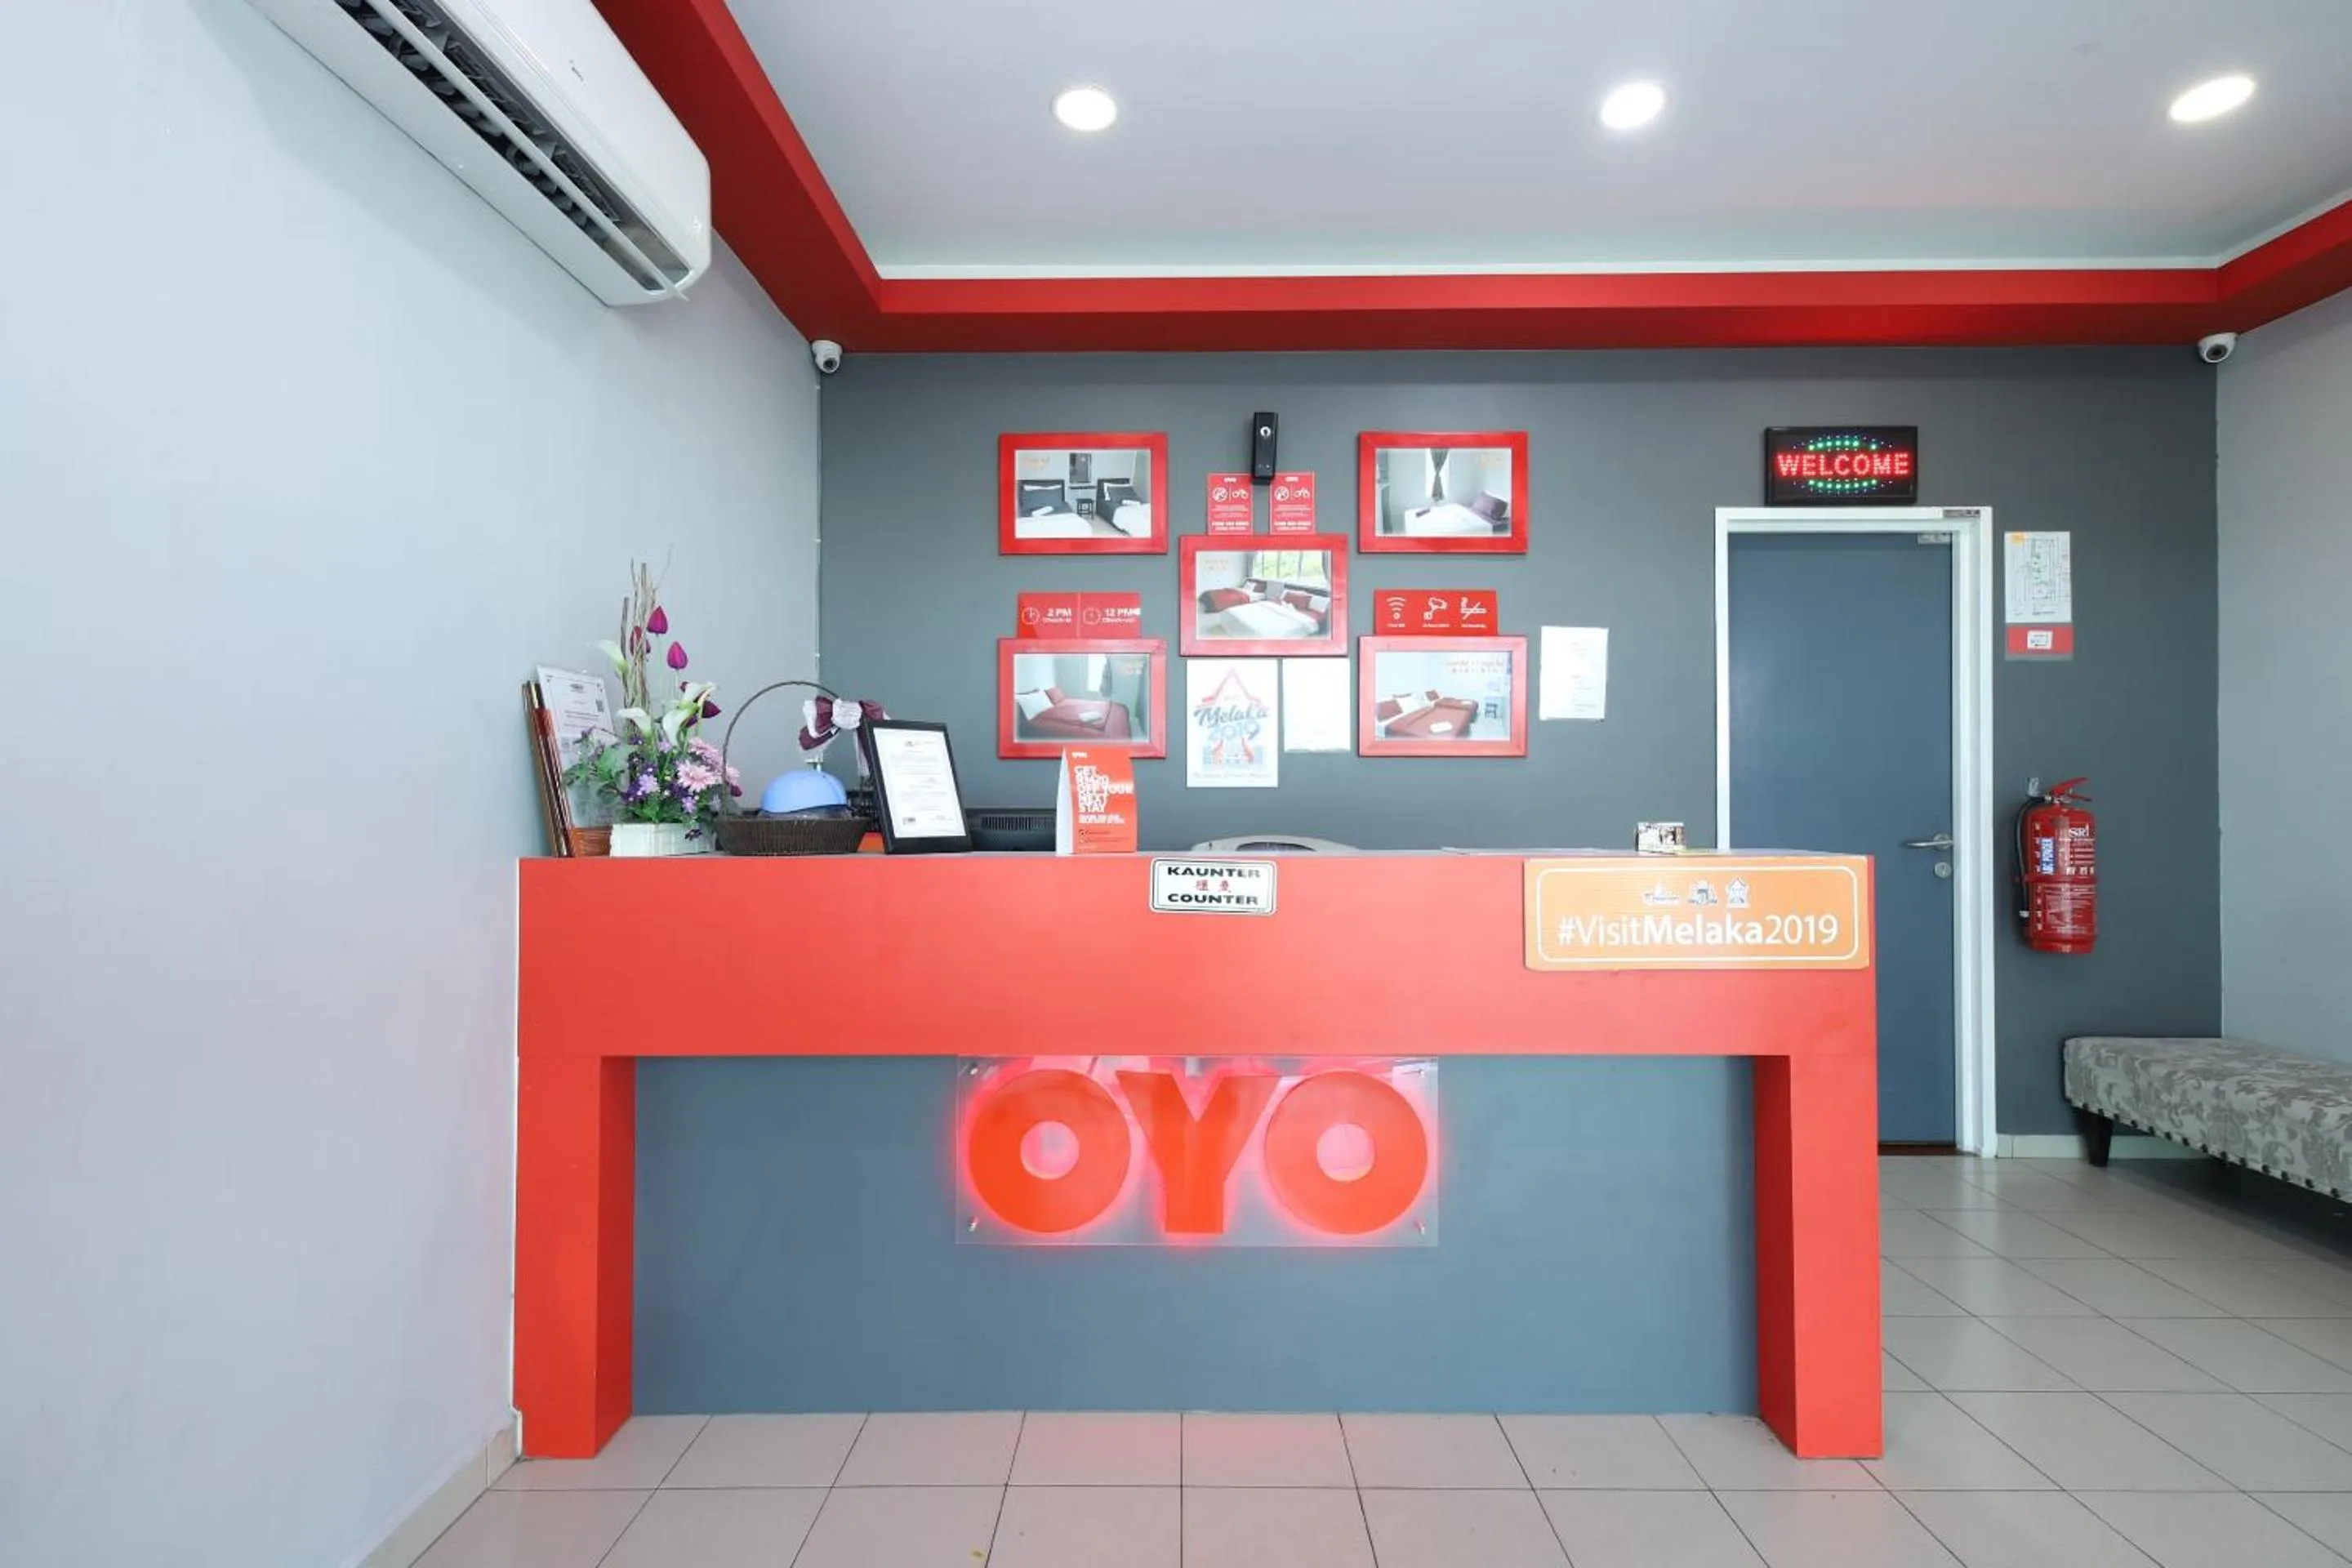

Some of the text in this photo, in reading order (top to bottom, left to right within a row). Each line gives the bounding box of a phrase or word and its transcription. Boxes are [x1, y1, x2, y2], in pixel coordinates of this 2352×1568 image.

[1776, 452, 1909, 476] WELCOME
[1047, 608, 1072, 617] 2 PM
[1106, 608, 1116, 617] 12
[1194, 703, 1270, 728] Melaka
[1208, 719, 1260, 741] 2019
[1168, 866, 1260, 878] KAUNTER
[1168, 893, 1258, 905] COUNTER
[1557, 913, 1838, 947] #VisitMelaka2019
[968, 1069, 1428, 1235] OYO
